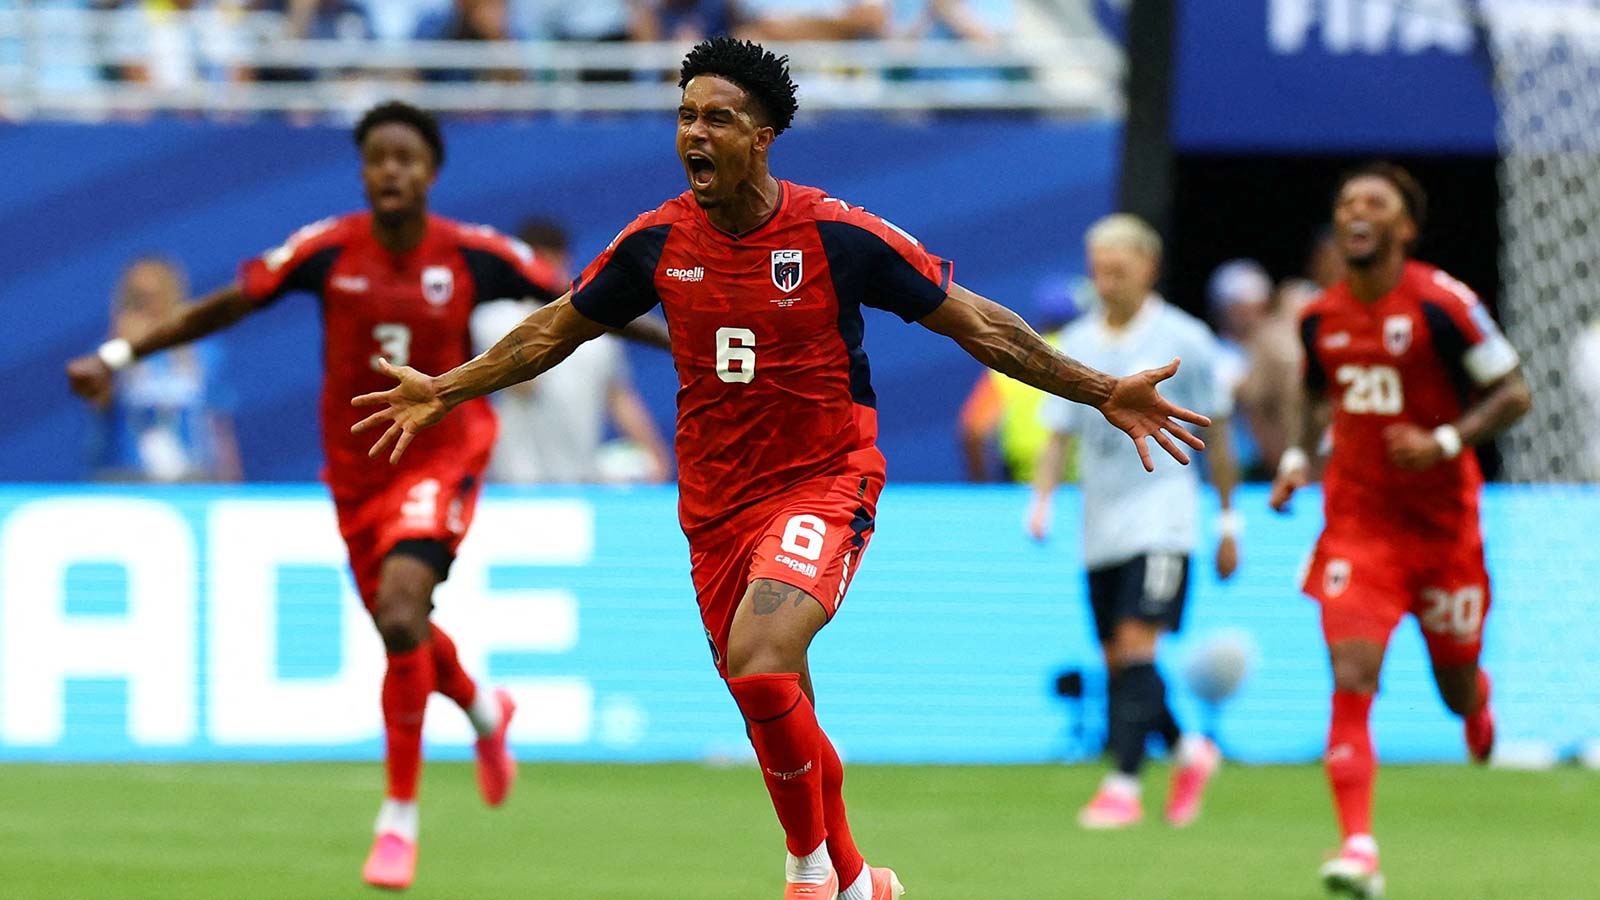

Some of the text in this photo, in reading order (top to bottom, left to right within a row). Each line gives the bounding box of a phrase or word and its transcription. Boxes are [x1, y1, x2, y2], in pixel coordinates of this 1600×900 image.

[666, 267, 704, 280] capelli
[774, 252, 800, 260] FCF
[370, 323, 411, 372] 3
[716, 327, 756, 383] 6
[1337, 364, 1402, 415] 20
[781, 515, 826, 560] 6
[775, 554, 817, 577] capelli
[1421, 585, 1483, 643] 20
